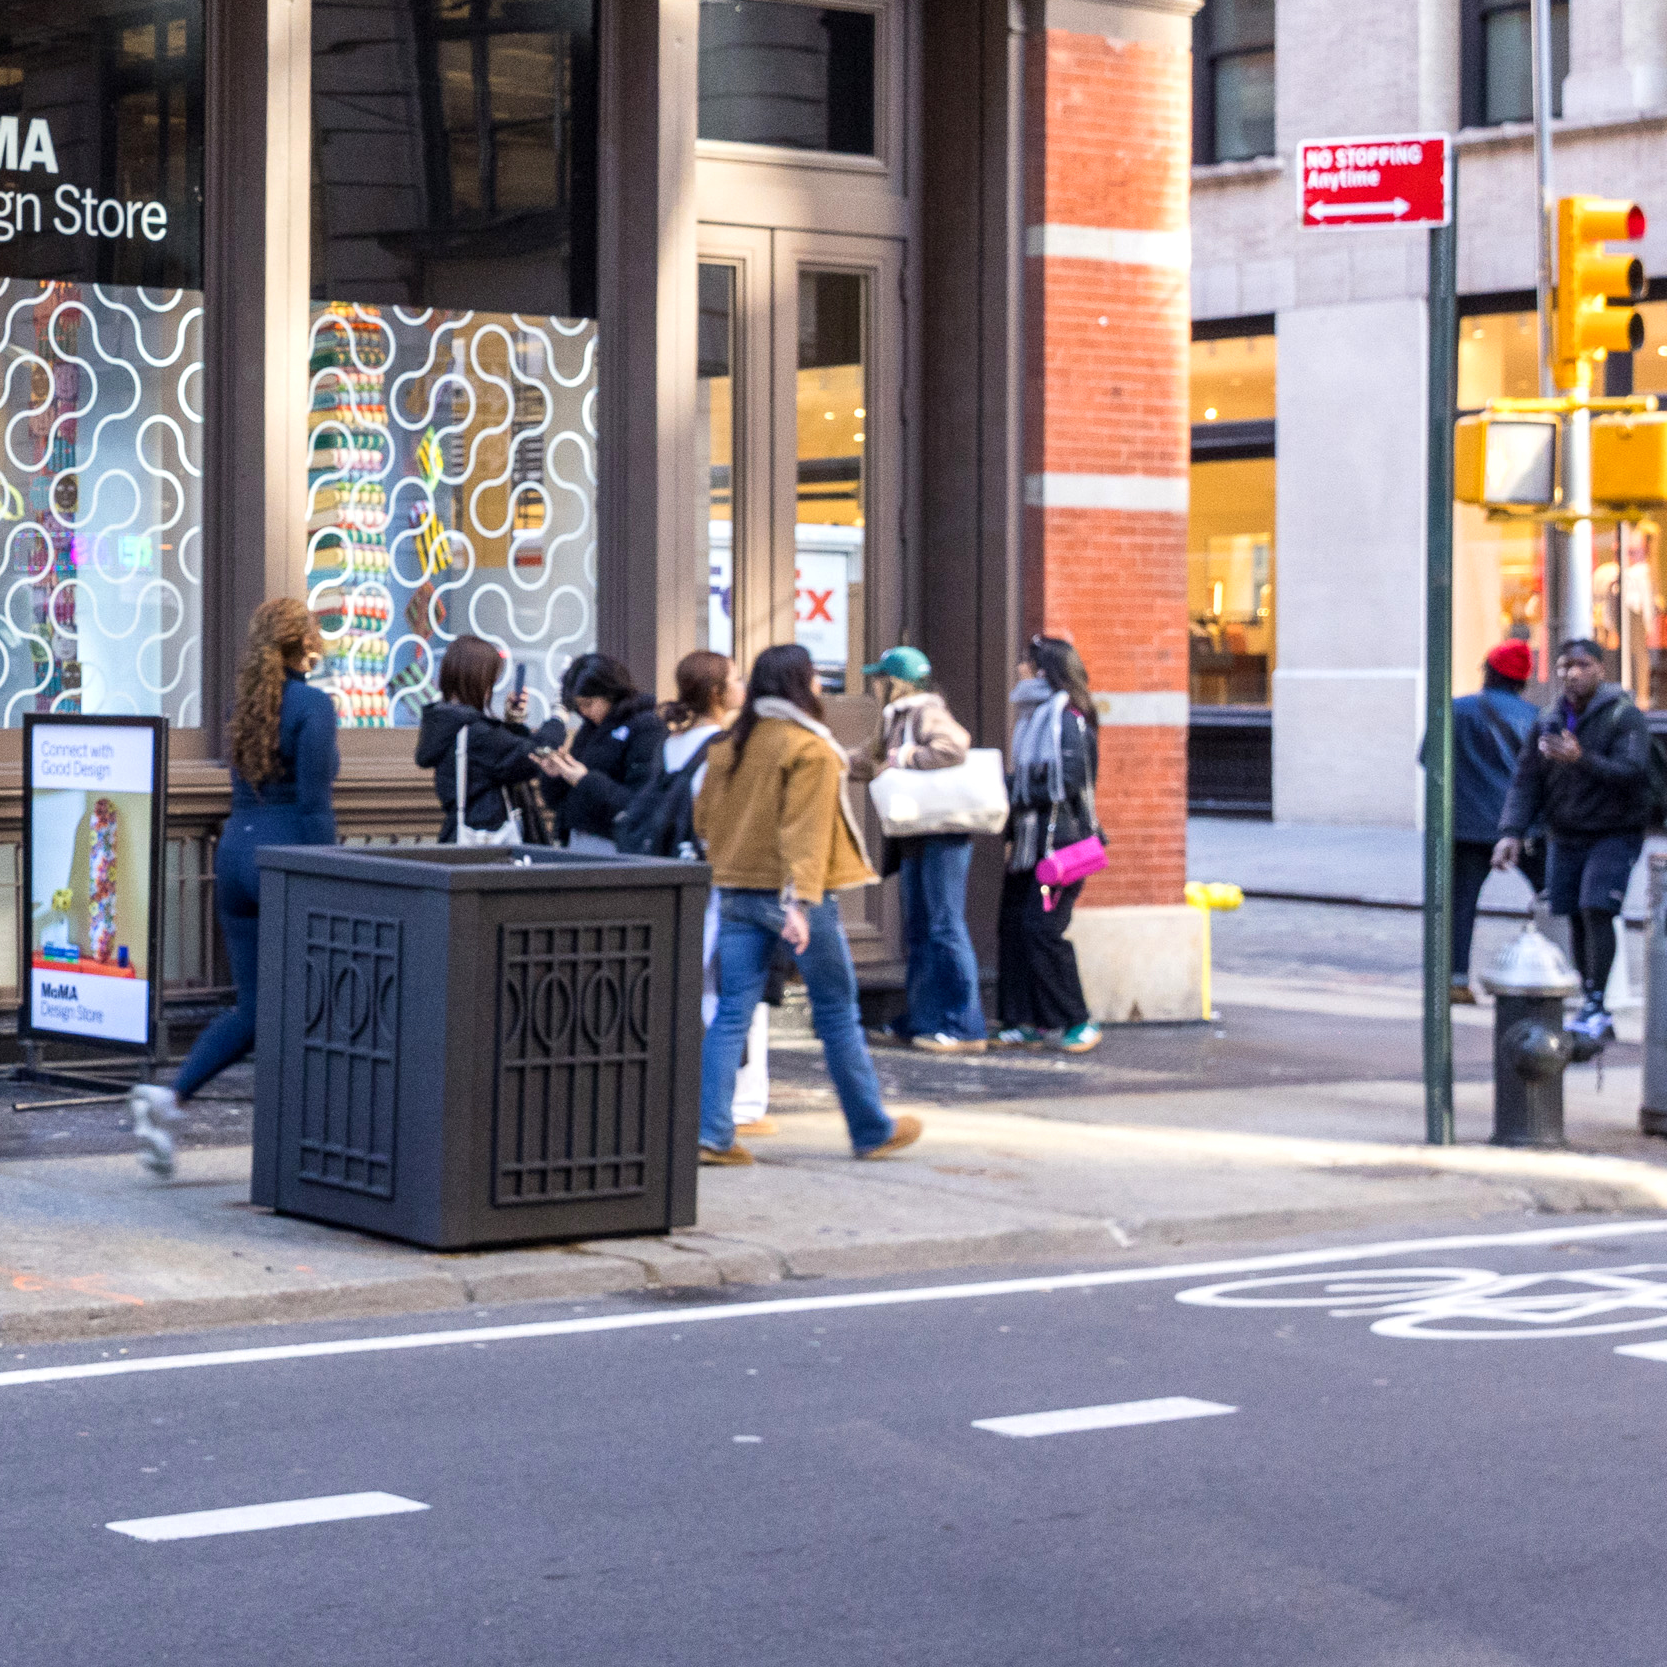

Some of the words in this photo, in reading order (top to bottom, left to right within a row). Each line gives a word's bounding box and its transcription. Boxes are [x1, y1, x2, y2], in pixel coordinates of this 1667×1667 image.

[1306, 148, 1334, 170] NO
[1335, 143, 1424, 169] STOPPING
[1307, 169, 1382, 193] Anytime
[53, 183, 168, 242] Store
[41, 740, 88, 757] Connect
[90, 742, 115, 758] with
[41, 759, 70, 777] Good
[72, 760, 112, 781] Design
[41, 981, 79, 1001] MoMA
[40, 1000, 75, 1023] Design
[76, 1004, 104, 1024] Store
